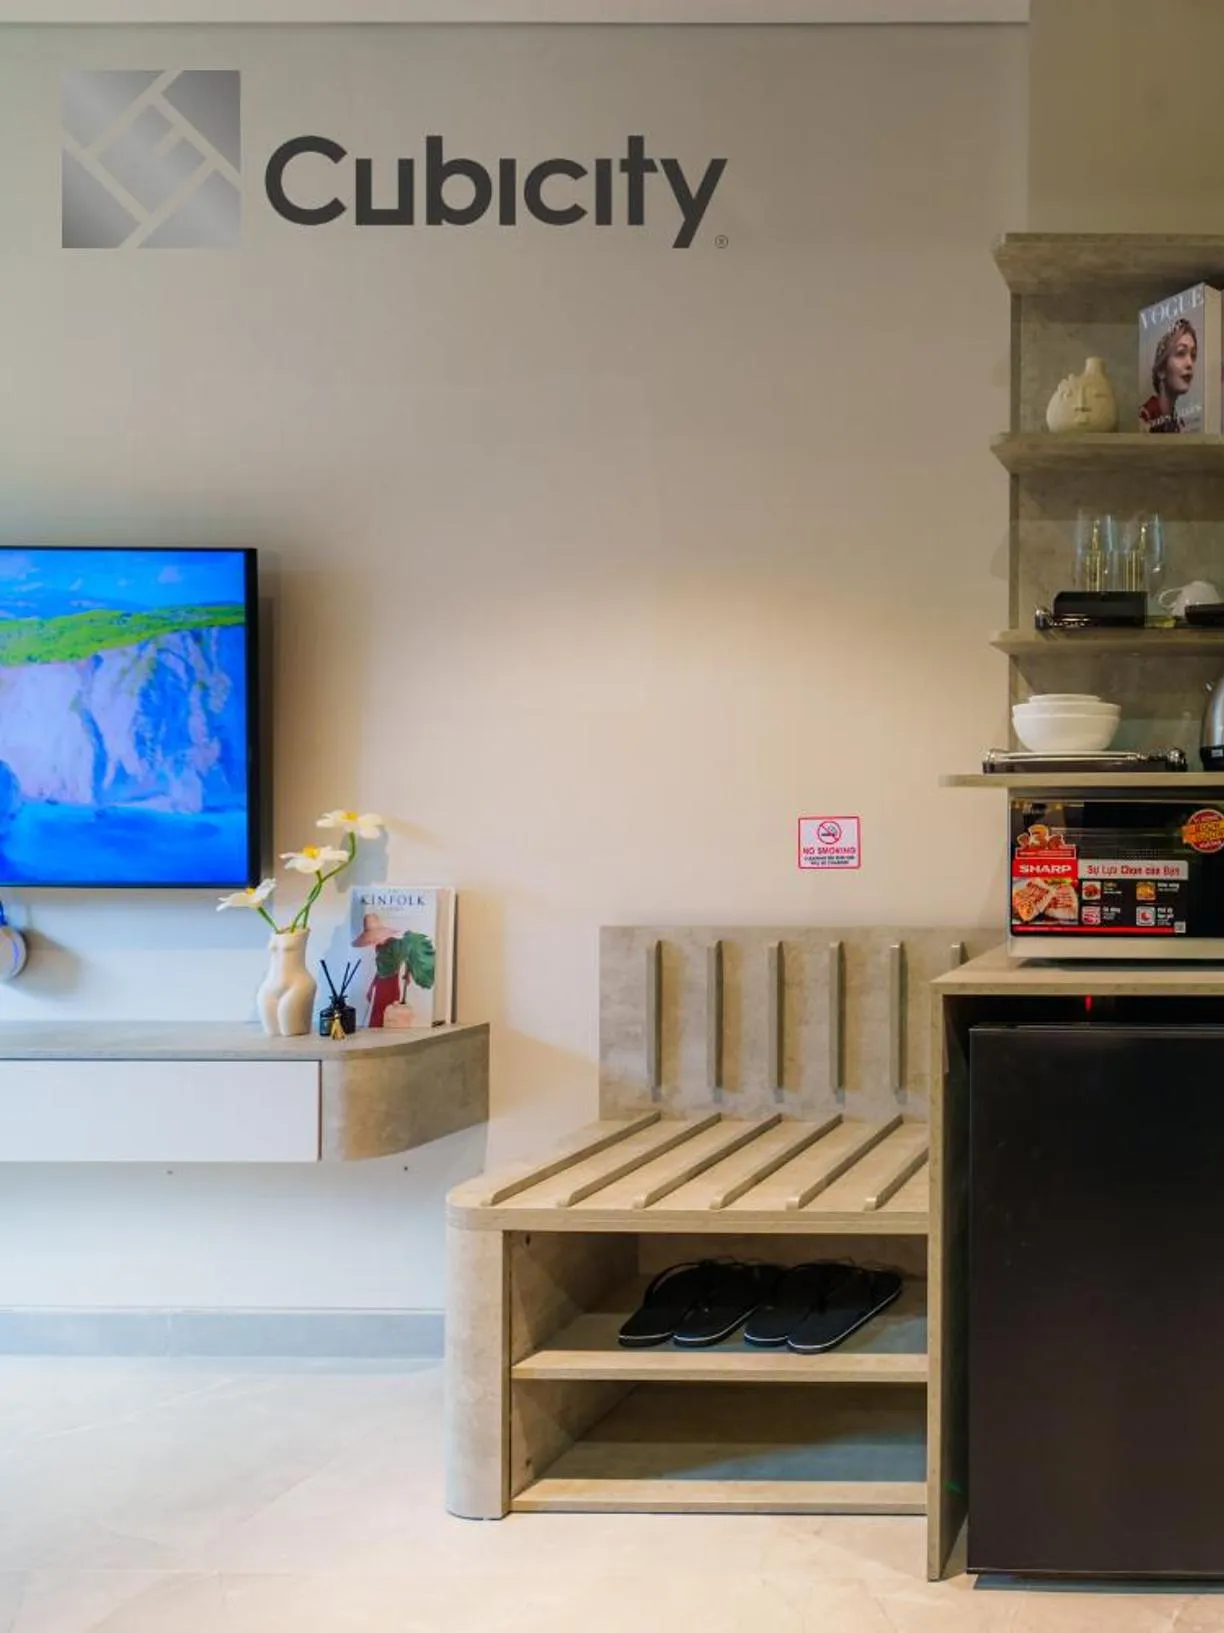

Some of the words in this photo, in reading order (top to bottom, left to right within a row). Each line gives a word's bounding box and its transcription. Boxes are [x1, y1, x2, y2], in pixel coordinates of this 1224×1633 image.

[1139, 285, 1204, 329] VOGUE
[803, 847, 815, 855] NO
[818, 847, 856, 855] SMOKING
[1019, 864, 1072, 874] SHARP
[361, 894, 427, 905] KINFOLK
